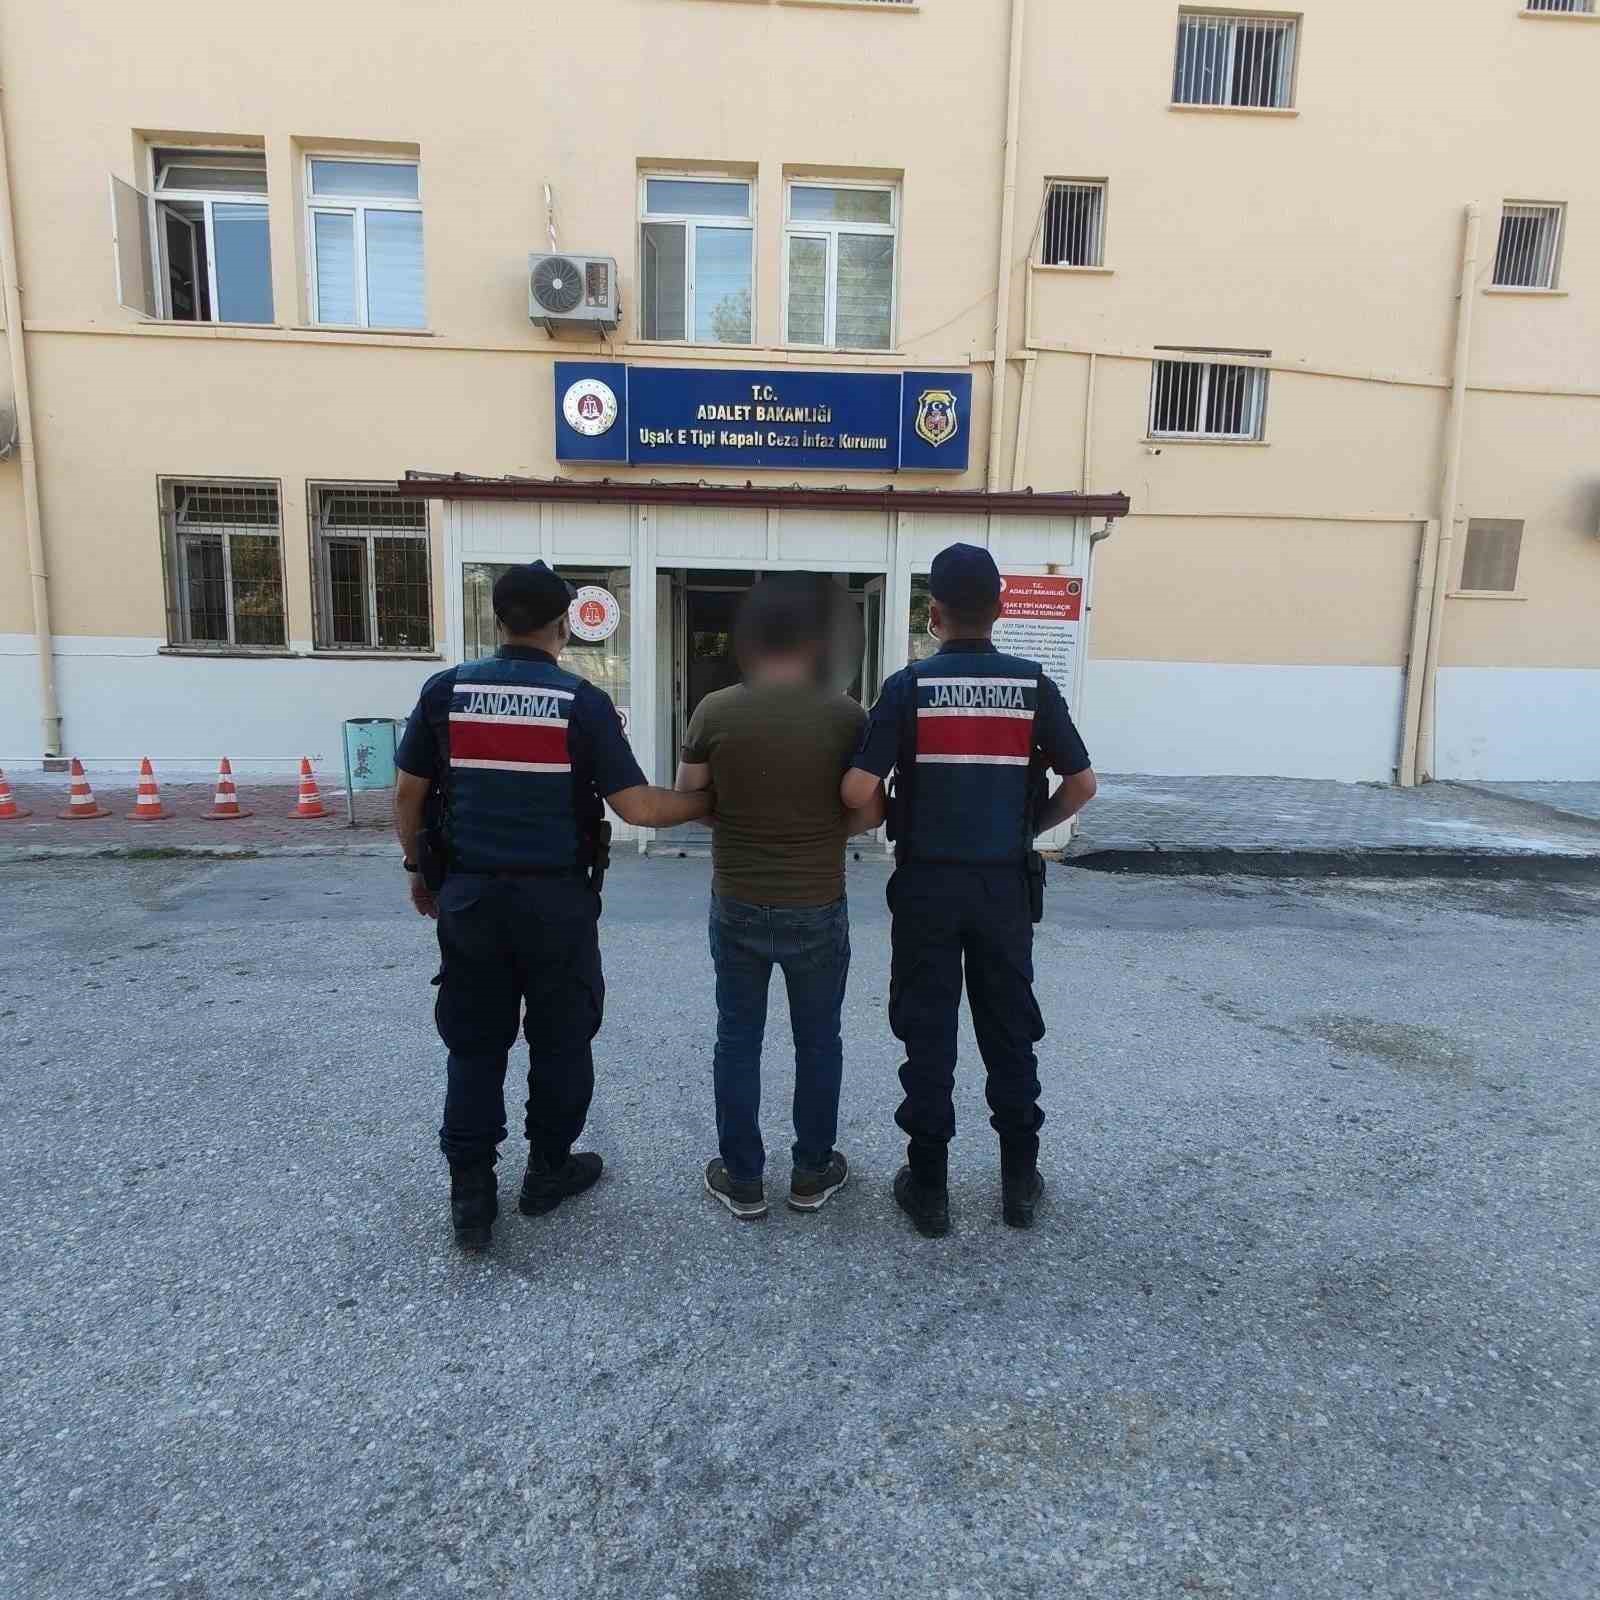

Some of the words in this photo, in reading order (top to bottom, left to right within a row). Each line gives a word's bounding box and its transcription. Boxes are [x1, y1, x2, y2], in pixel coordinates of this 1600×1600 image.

[752, 385, 778, 401] T.C.
[697, 404, 752, 420] ADALET
[756, 403, 832, 423] BAKANLIĞI
[640, 428, 674, 448] Uşak
[678, 429, 688, 445] E
[690, 430, 716, 448] Tipi
[720, 431, 764, 448] Kapalı
[767, 432, 799, 447] Ceza
[802, 430, 834, 448] İnfaz
[838, 433, 887, 449] Kurumu
[463, 692, 560, 719] JANDARMA
[929, 685, 1025, 708] JANDARMA
